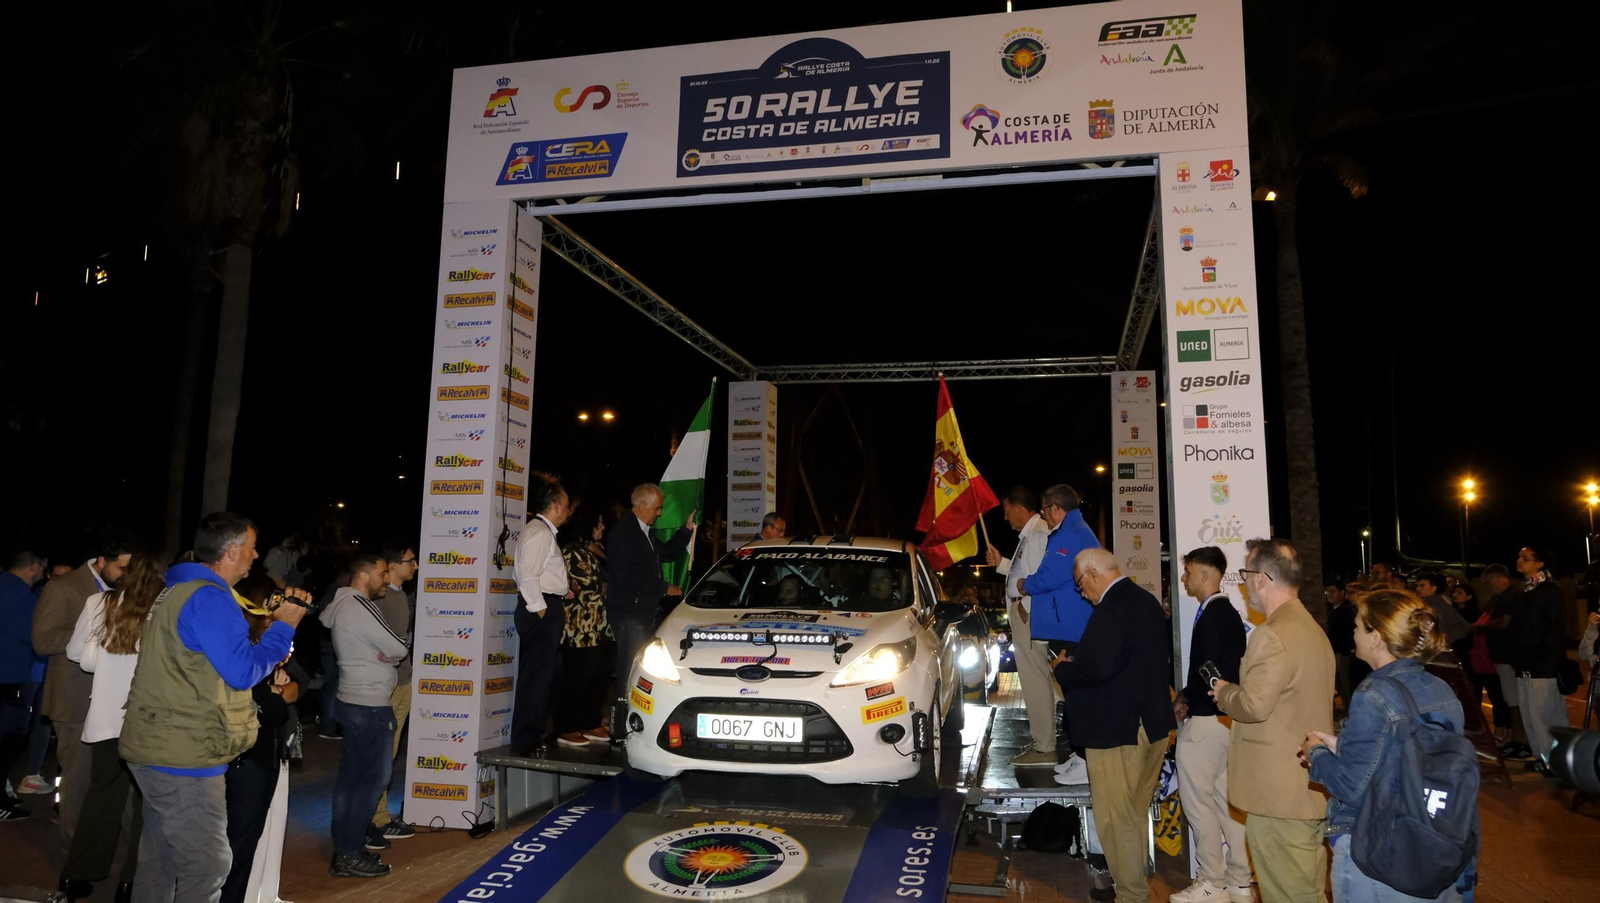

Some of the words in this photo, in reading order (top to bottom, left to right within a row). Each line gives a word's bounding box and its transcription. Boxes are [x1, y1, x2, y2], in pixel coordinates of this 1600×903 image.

[998, 33, 1034, 55] AUTOMOVIL
[1036, 36, 1051, 51] CLUB
[825, 61, 850, 69] COSTA
[1100, 51, 1155, 66] Andalucía
[1174, 64, 1204, 72] Andalucía
[702, 95, 753, 123] 50
[755, 79, 924, 119] RALLYE
[1123, 101, 1219, 122] DIPUTACIÓN
[702, 123, 774, 142] COSTA
[778, 121, 808, 137] DE
[814, 109, 920, 134] ALMERÍA
[1004, 115, 1050, 127] COSTA
[1053, 113, 1071, 124] DE
[1123, 123, 1144, 135] DE
[1147, 115, 1216, 133] ALMERÍA
[990, 124, 1073, 146] ALMERÍA
[545, 139, 611, 158] CERA
[557, 162, 598, 176] Recalvi
[448, 270, 496, 281] Rallycar
[454, 294, 486, 305] Recalvi
[1175, 296, 1248, 317] MOYA
[1180, 341, 1208, 351] UNED
[442, 362, 490, 374] Rallycar
[1179, 370, 1251, 393] gasolia
[448, 388, 479, 398] Recalvi
[1209, 410, 1251, 419] Fornieles
[1210, 420, 1218, 429] &
[1220, 420, 1252, 428] albesa
[1117, 446, 1153, 457] MOYA
[1184, 444, 1254, 462] Phonika
[435, 455, 484, 468] Rallycar
[440, 482, 474, 492] Recalvi
[1118, 484, 1154, 495] gasolia
[1120, 520, 1155, 530] Phonika
[1197, 519, 1243, 544] Enix
[429, 552, 477, 565] Rallycar
[754, 552, 799, 560] PACO
[799, 552, 889, 563] ALABARCE
[435, 580, 468, 590] Recalvi
[423, 653, 472, 666] Rallycar
[429, 681, 462, 692] Recalvi
[866, 700, 903, 720] PIRELLI
[711, 718, 753, 737] 0067
[763, 721, 796, 738] GNJ
[417, 756, 467, 771] Rallycar
[423, 786, 457, 796] Recalvi
[653, 827, 762, 847] AUTOMOVIL
[771, 835, 800, 857] CLUB
[896, 825, 938, 898] sores.es
[648, 882, 745, 898] ALMERIA
